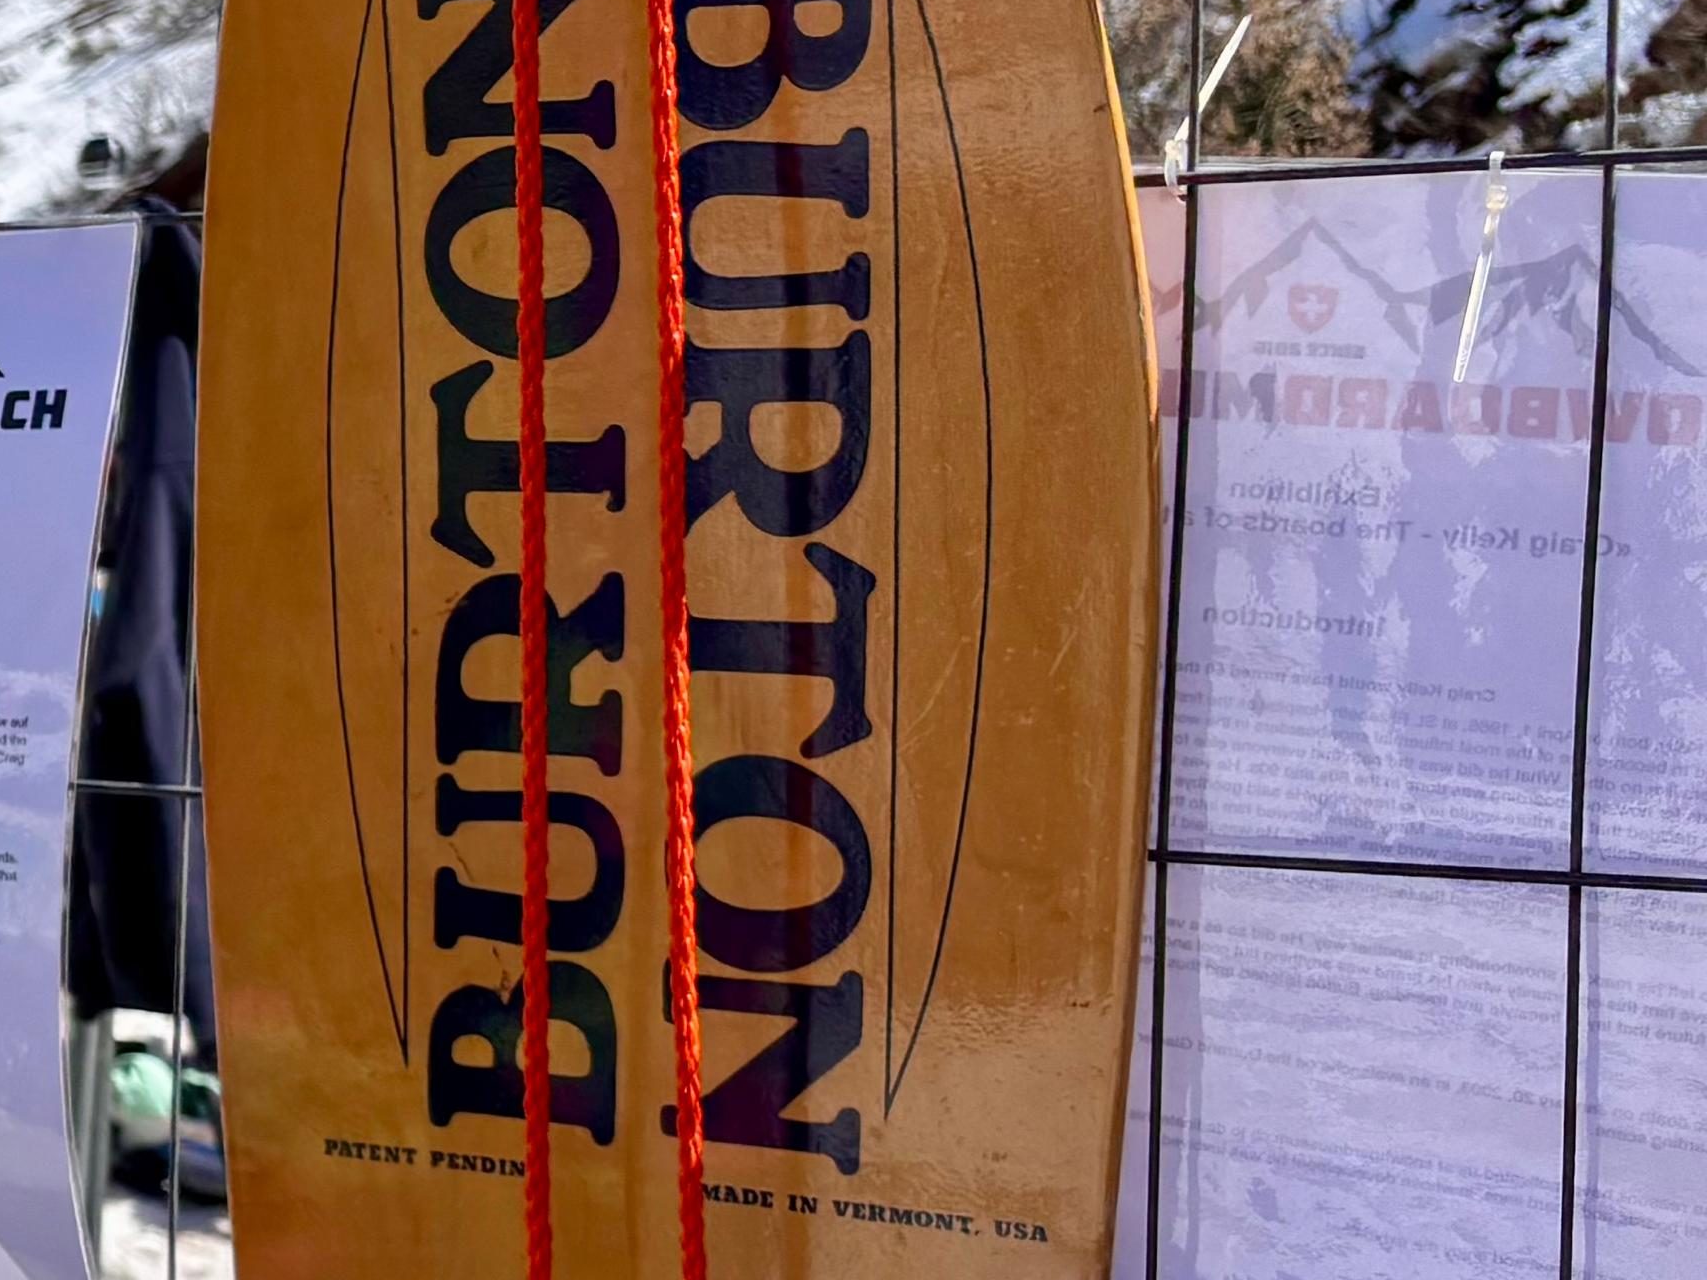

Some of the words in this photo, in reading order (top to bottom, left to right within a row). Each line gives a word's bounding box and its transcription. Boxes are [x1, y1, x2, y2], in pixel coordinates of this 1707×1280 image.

[324, 1138, 417, 1166] PATENT
[430, 1150, 527, 1177] PENDIN
[701, 1182, 774, 1209] MADE
[787, 1193, 818, 1214] IN
[995, 1220, 1049, 1243] USA
